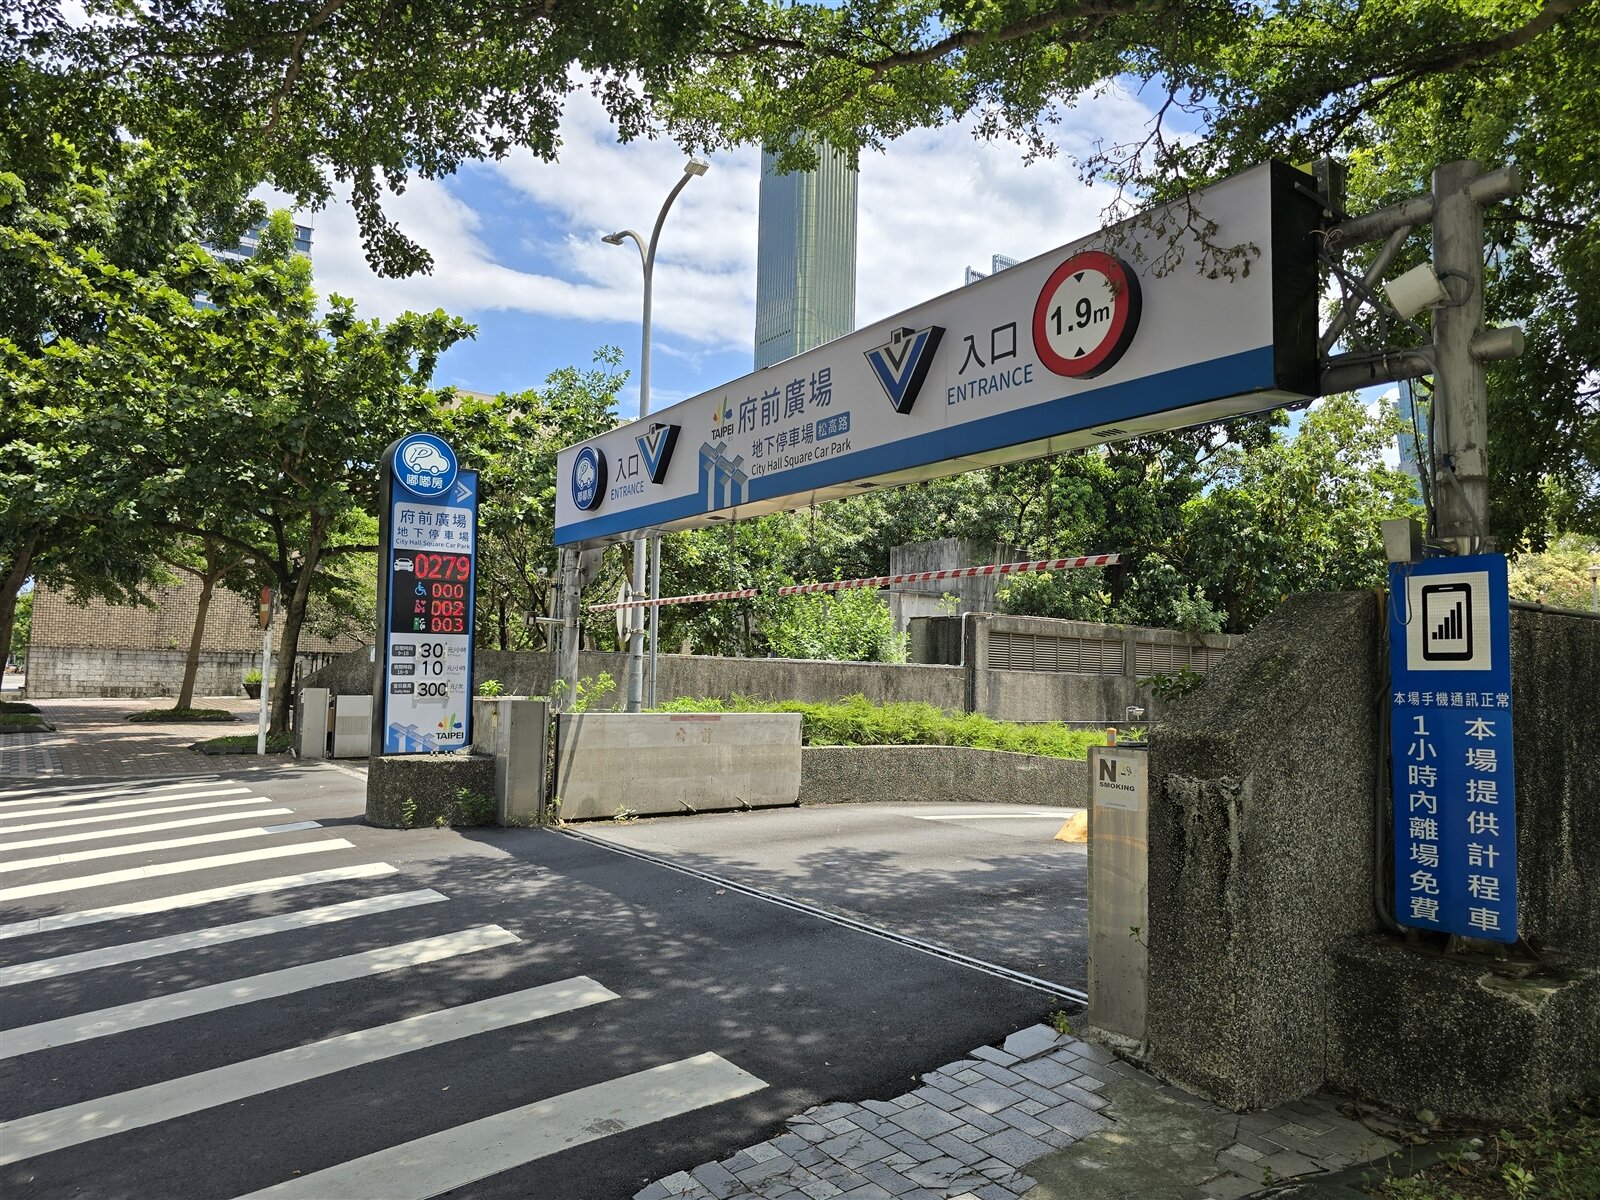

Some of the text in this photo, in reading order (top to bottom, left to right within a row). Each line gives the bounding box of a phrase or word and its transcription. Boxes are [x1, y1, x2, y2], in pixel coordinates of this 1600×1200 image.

[1050, 297, 1110, 336] 1.9m
[958, 321, 1017, 376] 入口
[947, 363, 1034, 406] ENTRANCE
[738, 367, 833, 434] 府前廣場
[711, 424, 735, 440] TAIPEI
[817, 415, 849, 438] 松高路
[751, 422, 814, 459] 地下停車場
[751, 437, 852, 476] City Hall Square Car Park
[616, 454, 639, 482] 入口
[406, 474, 444, 489] 嘟嘟房
[610, 480, 644, 501] ENTRANCE
[400, 509, 468, 529] 府前廣場
[395, 538, 409, 546] City
[423, 540, 444, 548] Square
[397, 527, 469, 542] 地下停車場
[414, 553, 470, 581] 0279
[432, 583, 464, 599] 000
[431, 600, 464, 616] 002
[431, 617, 464, 632] 003
[420, 642, 443, 659] 30
[422, 660, 443, 676] 10
[418, 682, 447, 697] 300
[1393, 691, 1510, 708] 本場手機通訊正常
[435, 731, 464, 741] TAIPEI
[1099, 781, 1136, 792] SMOKING
[1407, 715, 1440, 923] 1小時內離場免費
[1464, 717, 1501, 932] 本場提供計程車
